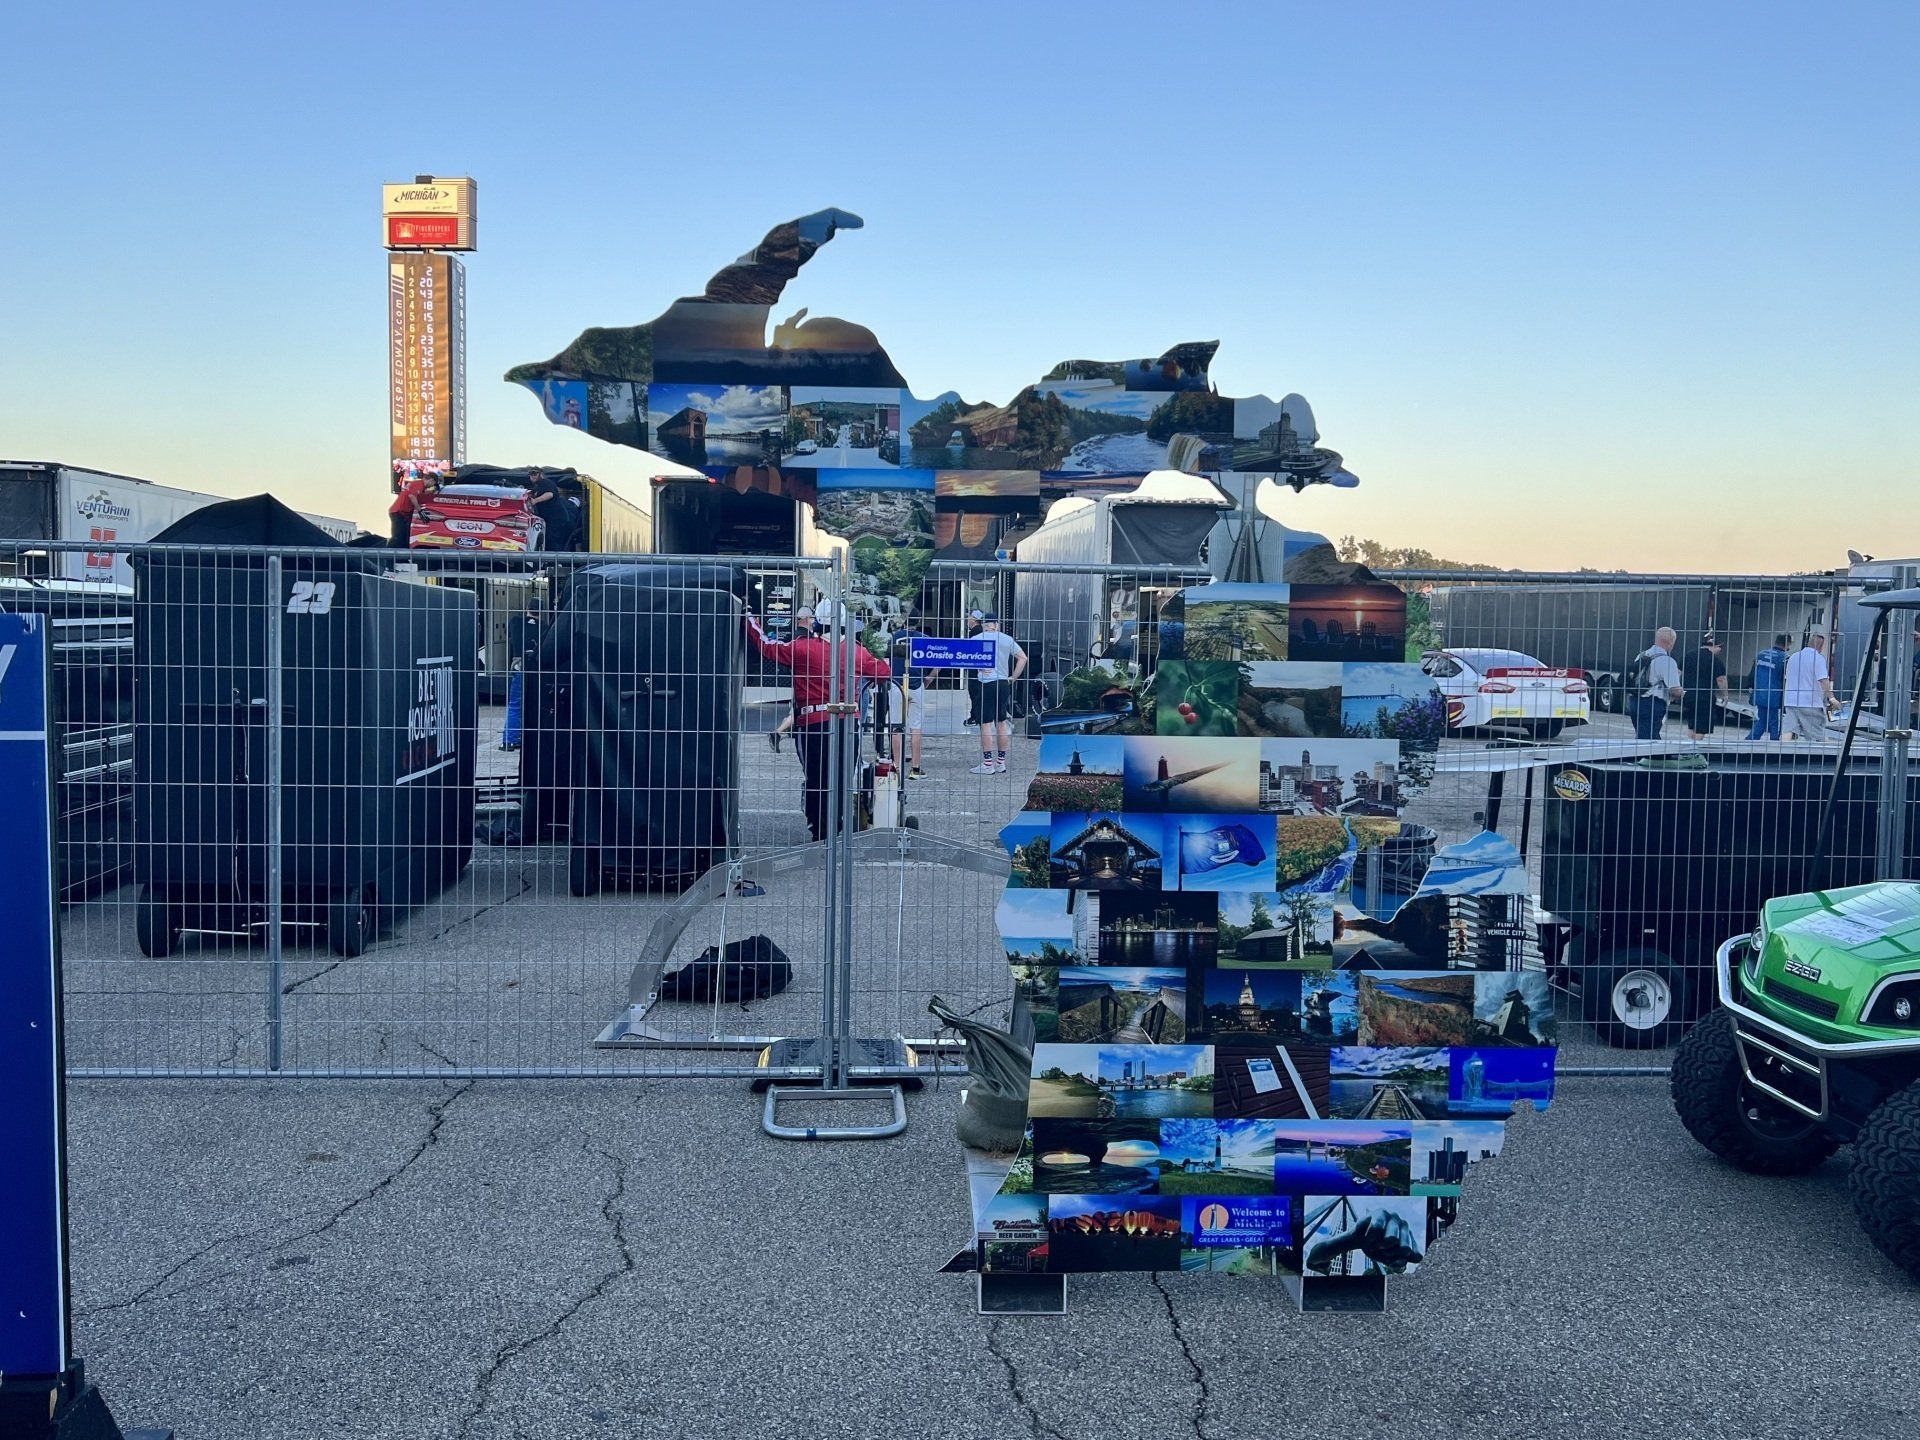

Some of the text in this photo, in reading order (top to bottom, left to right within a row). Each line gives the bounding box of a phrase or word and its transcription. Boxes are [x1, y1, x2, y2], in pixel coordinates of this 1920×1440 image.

[400, 190, 439, 200] MICHIGAN
[409, 266, 432, 276] 1 2
[408, 278, 432, 287] 2 20
[409, 290, 433, 299] 3 43
[409, 301, 433, 310] 4 18
[409, 312, 433, 322] 5 15
[409, 324, 433, 333] 6 6
[410, 336, 434, 345] 7 23
[410, 347, 434, 356] 8 72
[395, 299, 404, 418] MISPEEDWAY.com
[410, 358, 434, 368] 9 35
[408, 370, 434, 379] 10 11
[409, 381, 434, 390] 11 25
[409, 392, 434, 401] 12 97
[409, 404, 434, 413] 13 12
[409, 415, 434, 424] 14 65
[409, 427, 434, 435] 15 69
[411, 438, 434, 447] 18 30
[411, 449, 434, 458] 19 10
[76, 500, 130, 517] VENTURINI
[97, 514, 128, 522] MOTORSPORTS
[457, 522, 482, 531] ICON
[286, 580, 336, 614] 23
[926, 651, 992, 660] Onsite Services
[1554, 776, 1591, 793] MENARDS
[1232, 1208, 1285, 1216] Welcome to
[1234, 1219, 1283, 1230] Michigan
